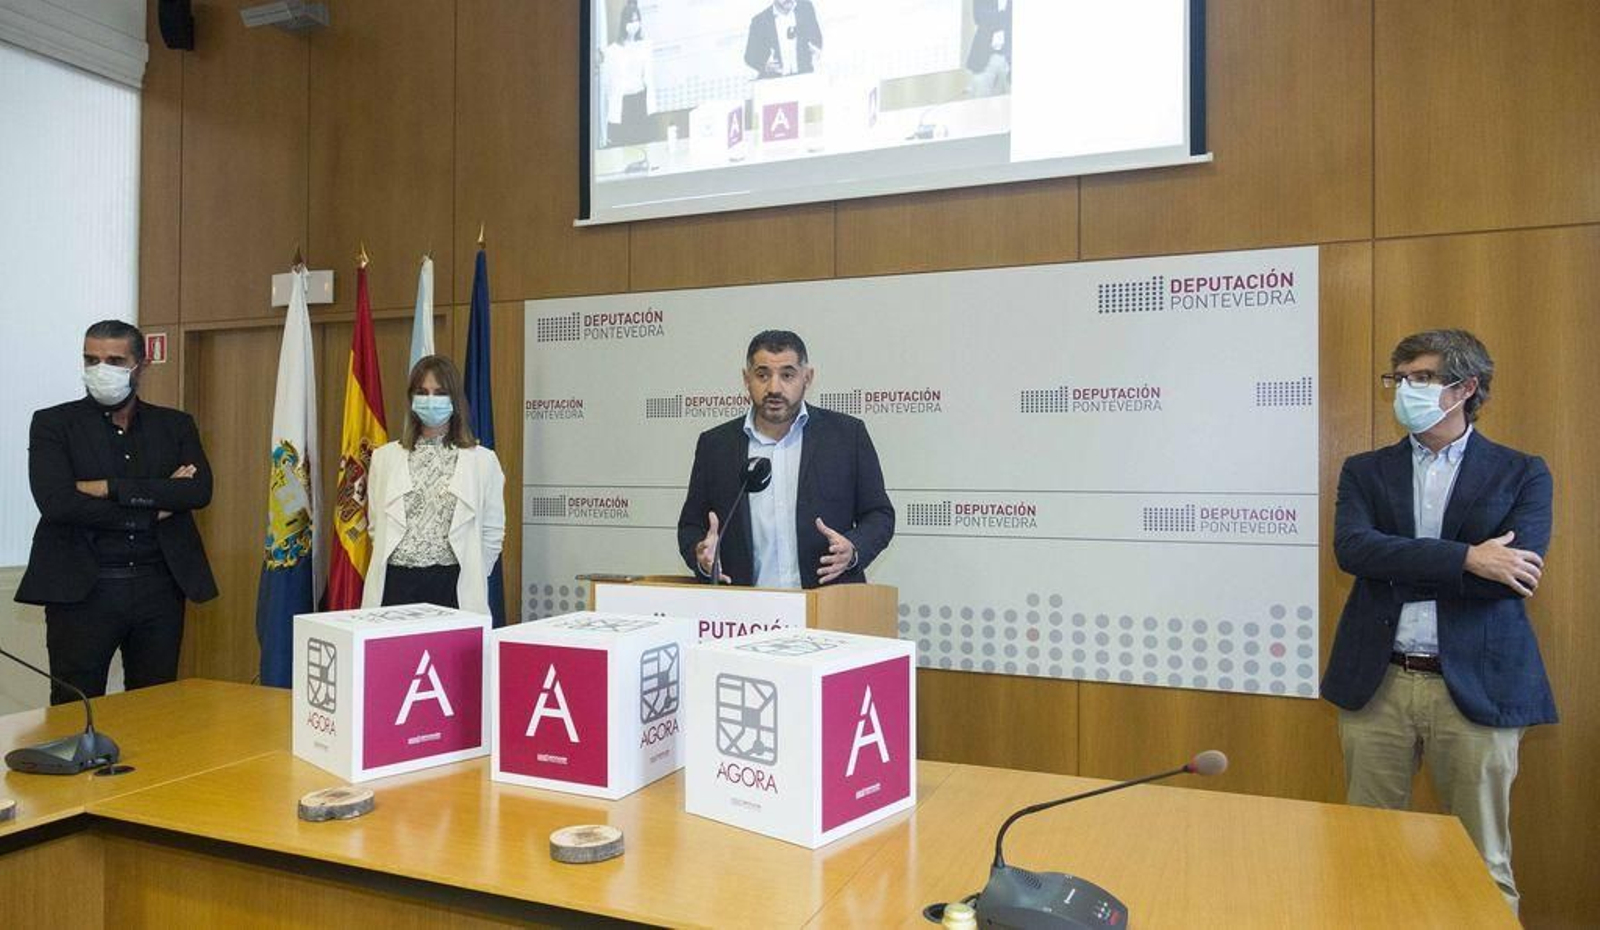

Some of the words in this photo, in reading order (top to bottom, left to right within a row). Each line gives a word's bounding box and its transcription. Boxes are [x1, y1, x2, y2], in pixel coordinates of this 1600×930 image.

[1170, 269, 1294, 293] DEPUTACIÓN
[1170, 290, 1296, 309] PONTEVEDRA
[583, 307, 663, 327] DEPUTACIÓN
[583, 325, 665, 340] PONTEVEDRA
[865, 387, 941, 402] DEPUTACIÓN
[1073, 384, 1161, 400] DEPUTACIÓN
[526, 397, 583, 410] DEPUTACIÓN
[865, 401, 942, 414] PONTEVEDRA
[1073, 397, 1162, 412] PONTEVEDRA
[526, 408, 584, 419] PONTEVEDRA
[568, 496, 629, 508] DEPUTACIÓN
[955, 502, 1036, 516] DEPUTACIÓN
[568, 508, 630, 518] PONTEVEDRA
[1201, 506, 1296, 521] DEPUTACIÓN
[955, 515, 1038, 529] PONTEVEDRA
[1200, 521, 1298, 535] PONTEVEDRA
